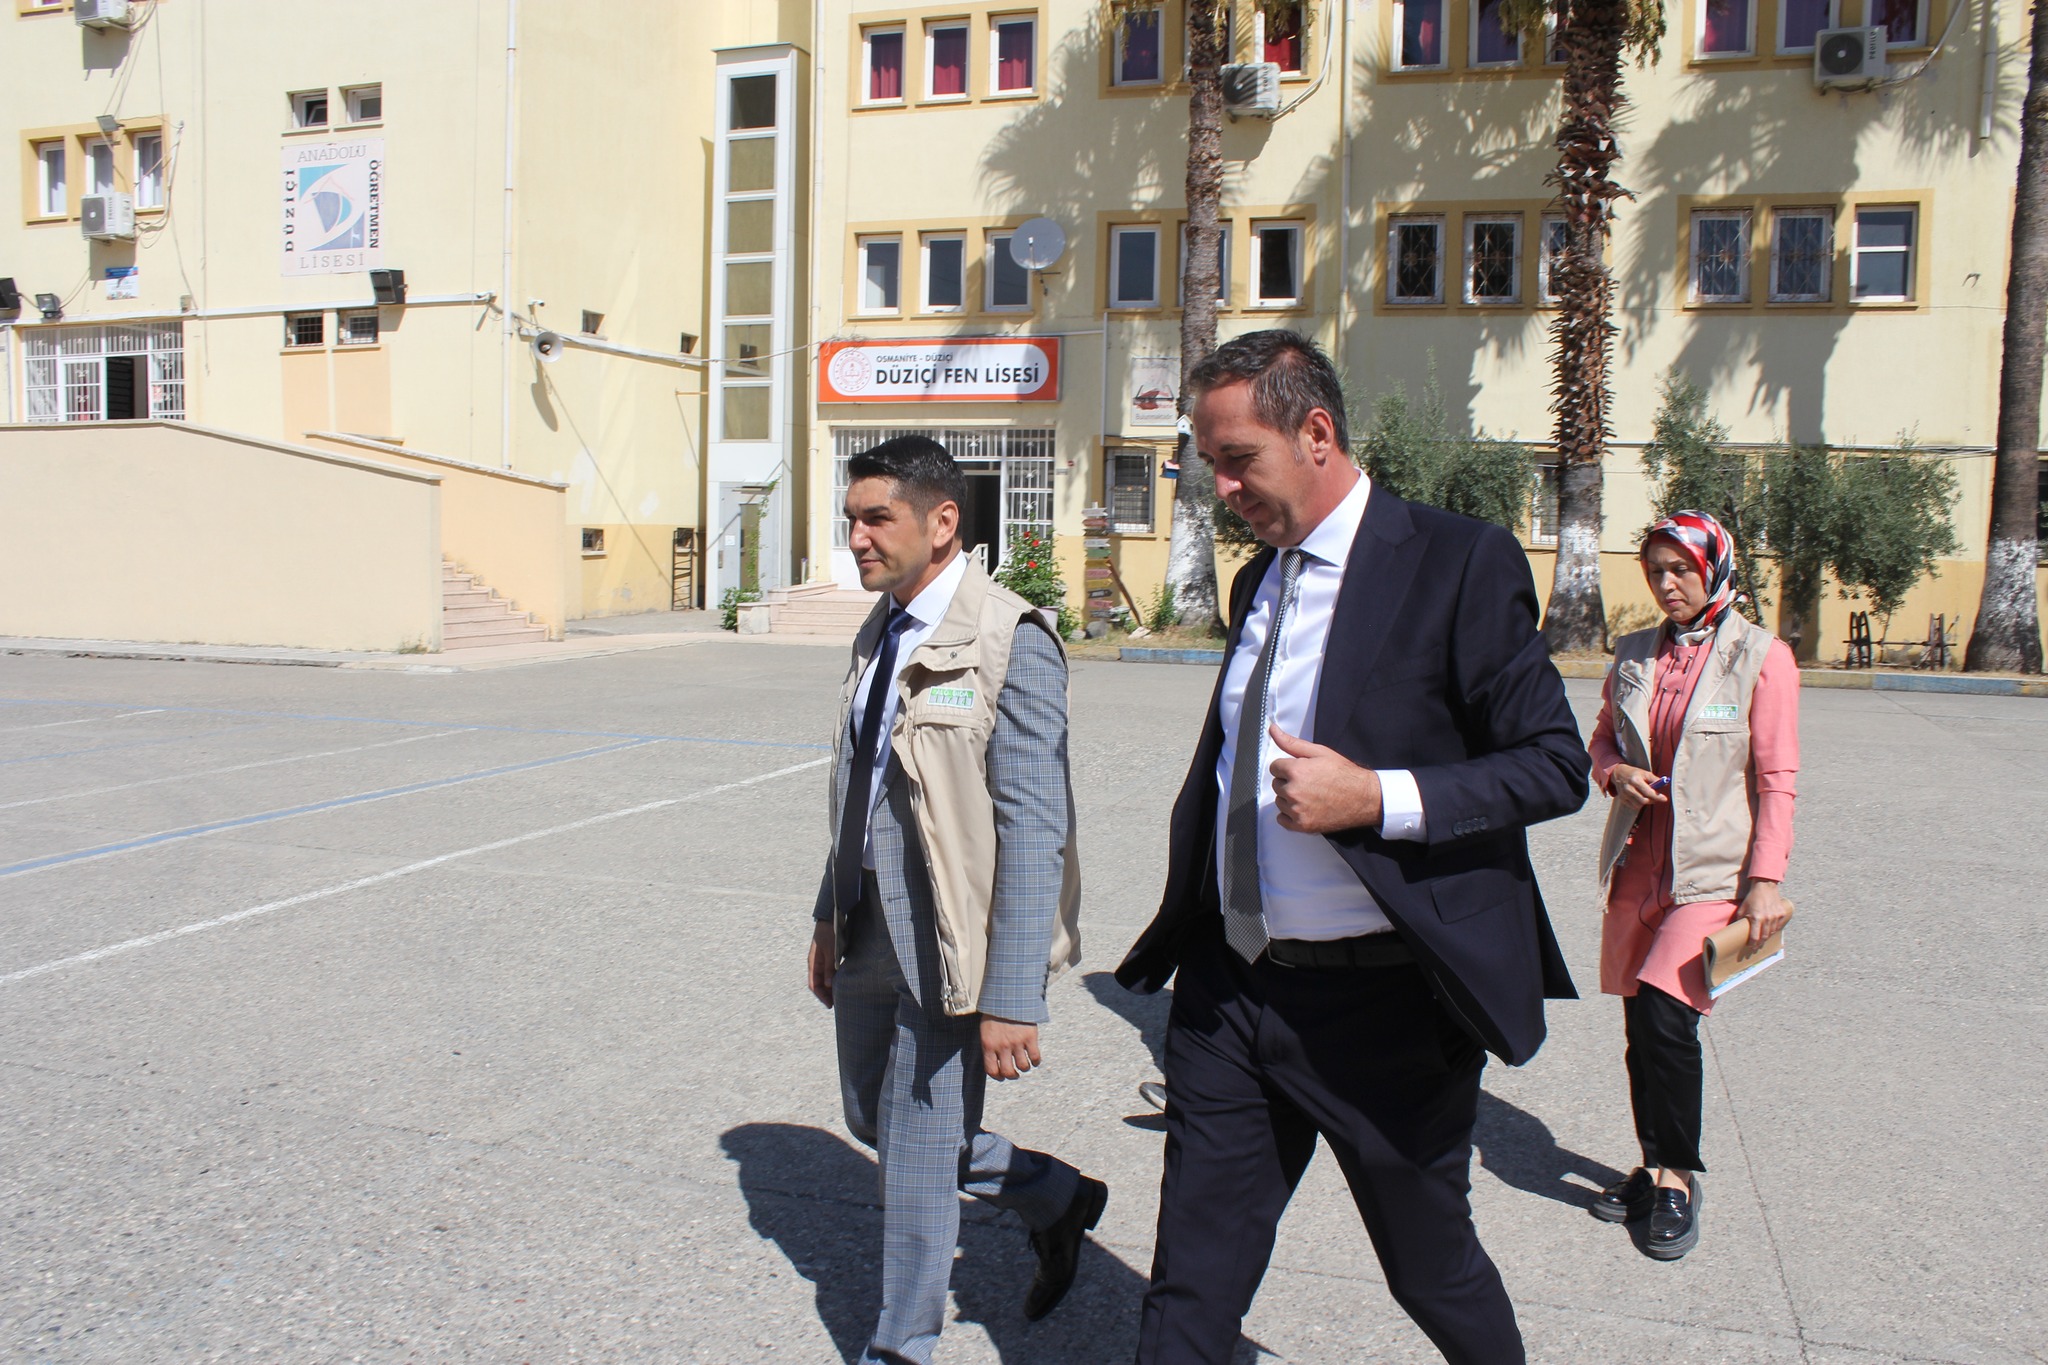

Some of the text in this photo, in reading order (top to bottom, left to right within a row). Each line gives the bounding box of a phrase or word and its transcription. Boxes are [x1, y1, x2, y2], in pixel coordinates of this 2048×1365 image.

[297, 144, 367, 163] ANADOLU
[283, 169, 297, 252] DÜZİÇİ
[369, 159, 382, 249] ÖĞRETMEN
[300, 253, 365, 269] LİSESİ
[876, 353, 917, 363] OSMANİYE
[925, 351, 954, 363] DÜZİÇİ
[876, 363, 937, 389] DÜZİÇİ
[944, 367, 978, 384] FEN
[985, 362, 1039, 384] LİSESİ
